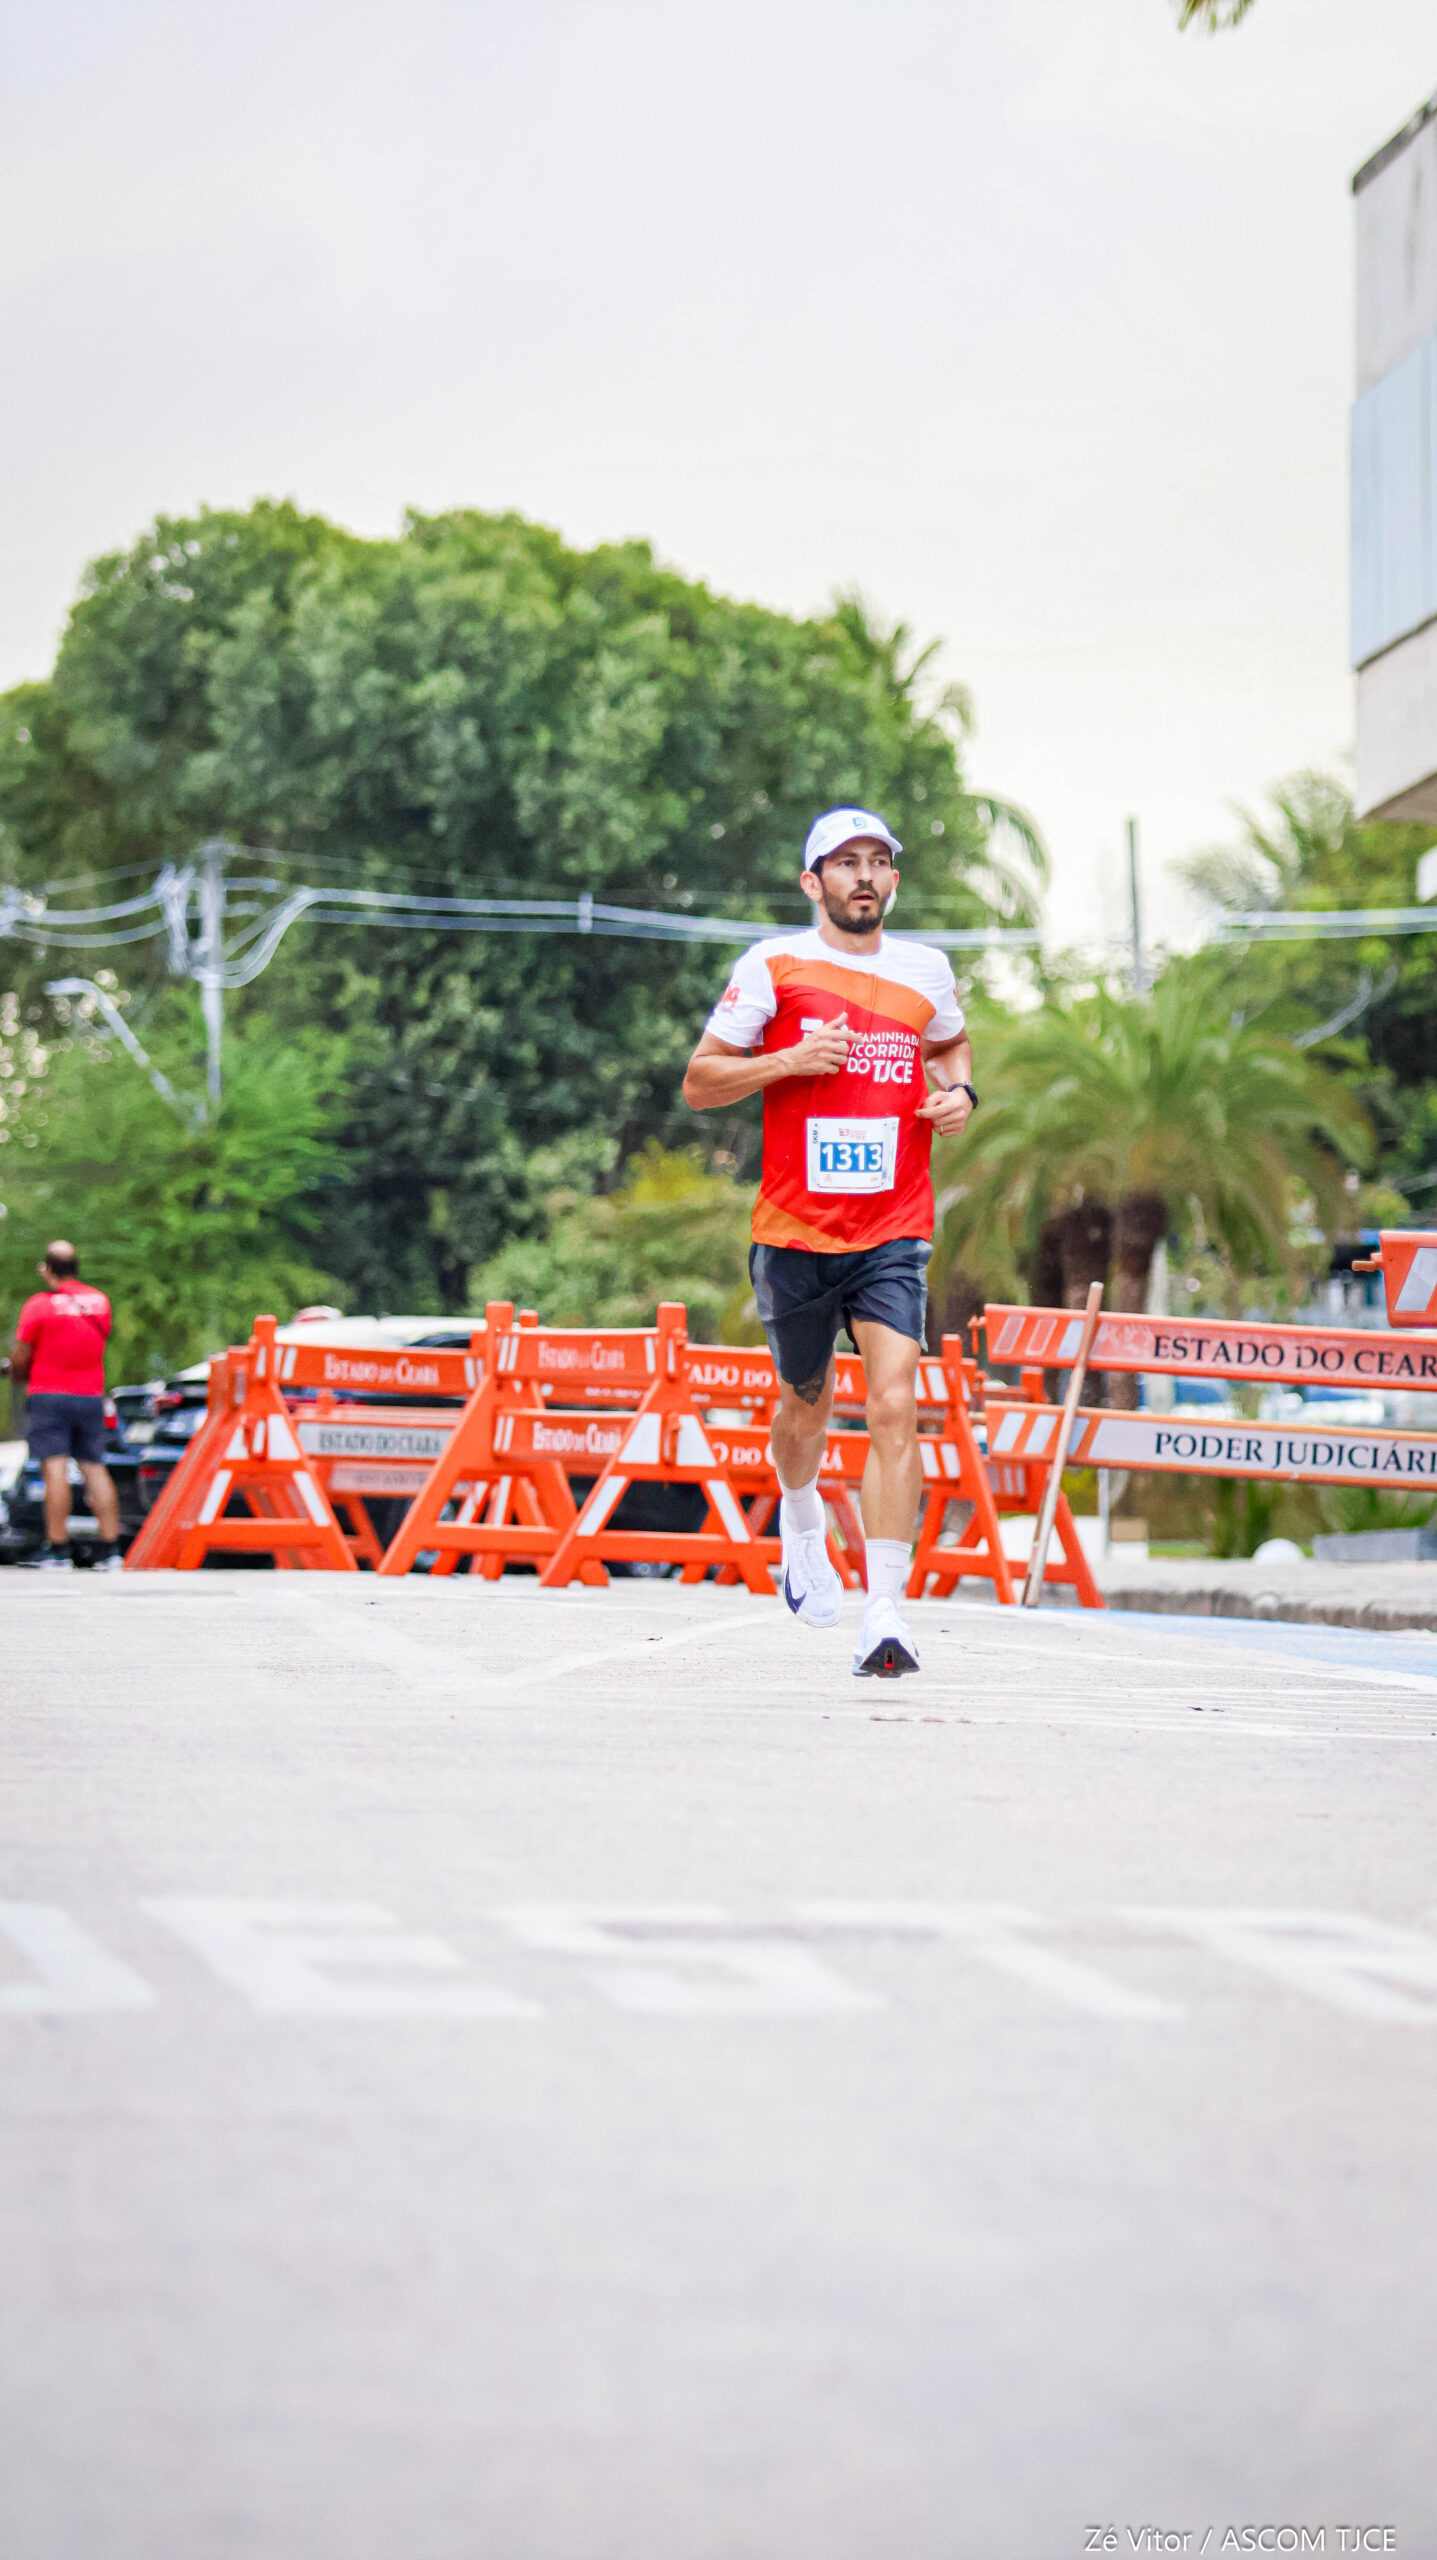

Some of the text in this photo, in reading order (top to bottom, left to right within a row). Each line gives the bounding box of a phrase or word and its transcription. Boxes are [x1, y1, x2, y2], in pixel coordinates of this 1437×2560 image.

[858, 1032, 920, 1047] AMINHADA
[847, 1057, 913, 1083] DO TJCE
[822, 1144, 882, 1171] 1313
[1153, 1335, 1285, 1368] ESTADO
[1296, 1345, 1344, 1371] DO
[684, 1362, 773, 1388] ADO DO
[732, 1446, 762, 1466] DO
[1155, 1432, 1264, 1462] PODER
